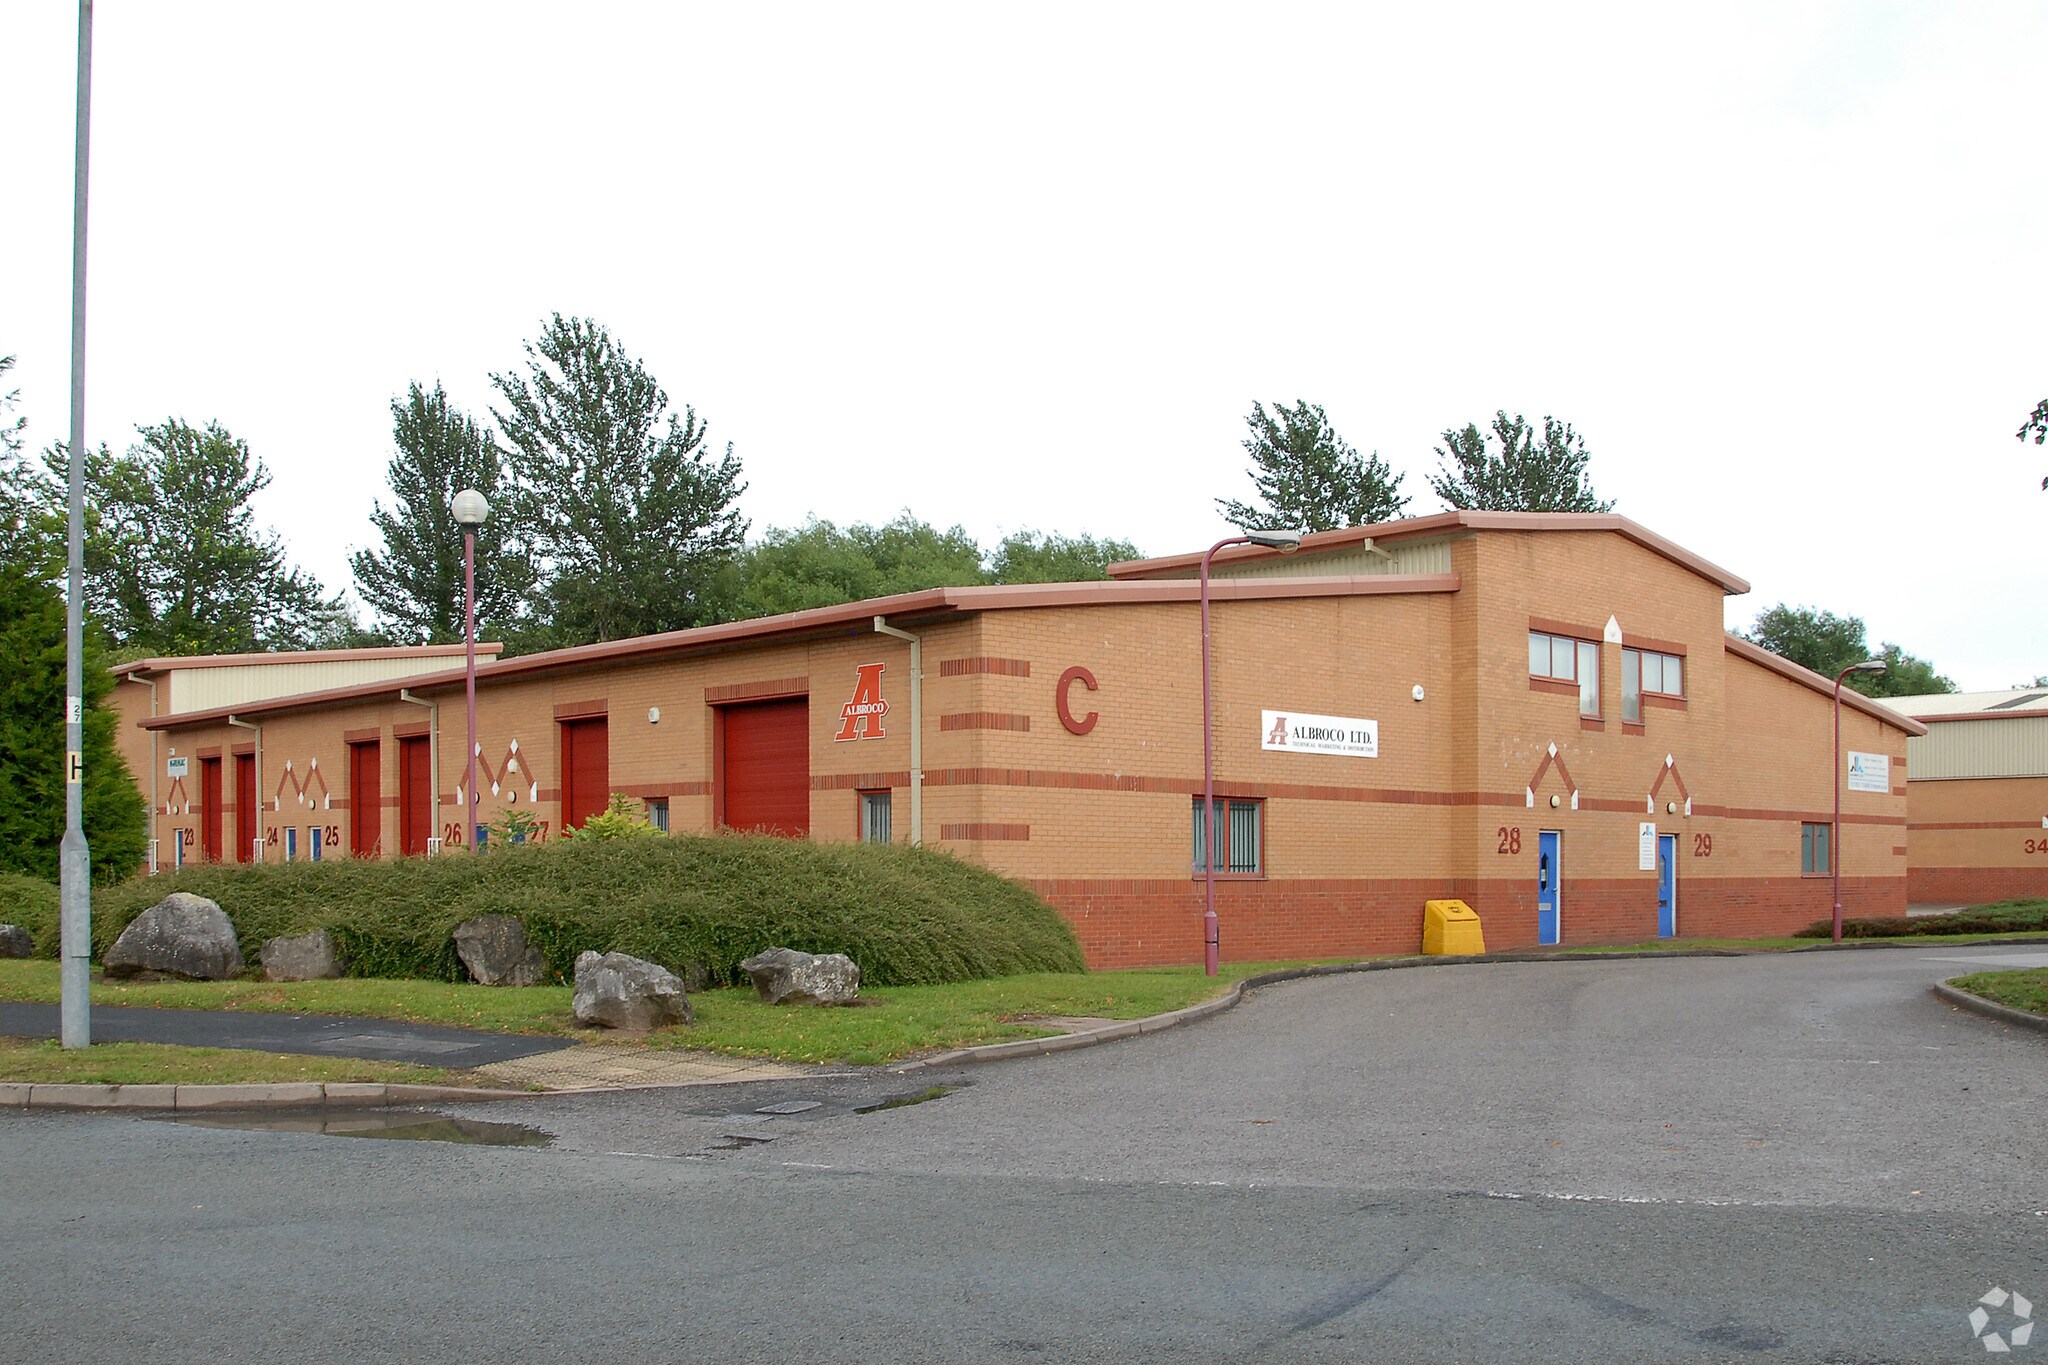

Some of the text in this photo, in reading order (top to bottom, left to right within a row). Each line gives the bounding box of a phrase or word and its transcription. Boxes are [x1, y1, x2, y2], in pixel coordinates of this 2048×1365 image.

[845, 702, 884, 717] ALBROCO
[1056, 666, 1099, 736] C
[1292, 726, 1373, 745] ALBROCO LTD.
[184, 827, 194, 846] 23
[267, 827, 278, 846] 24
[325, 825, 339, 846] 25
[445, 823, 462, 847] 26
[1498, 826, 1522, 855] 28
[1694, 833, 1713, 857] 29
[2024, 838, 2048, 855] 34
